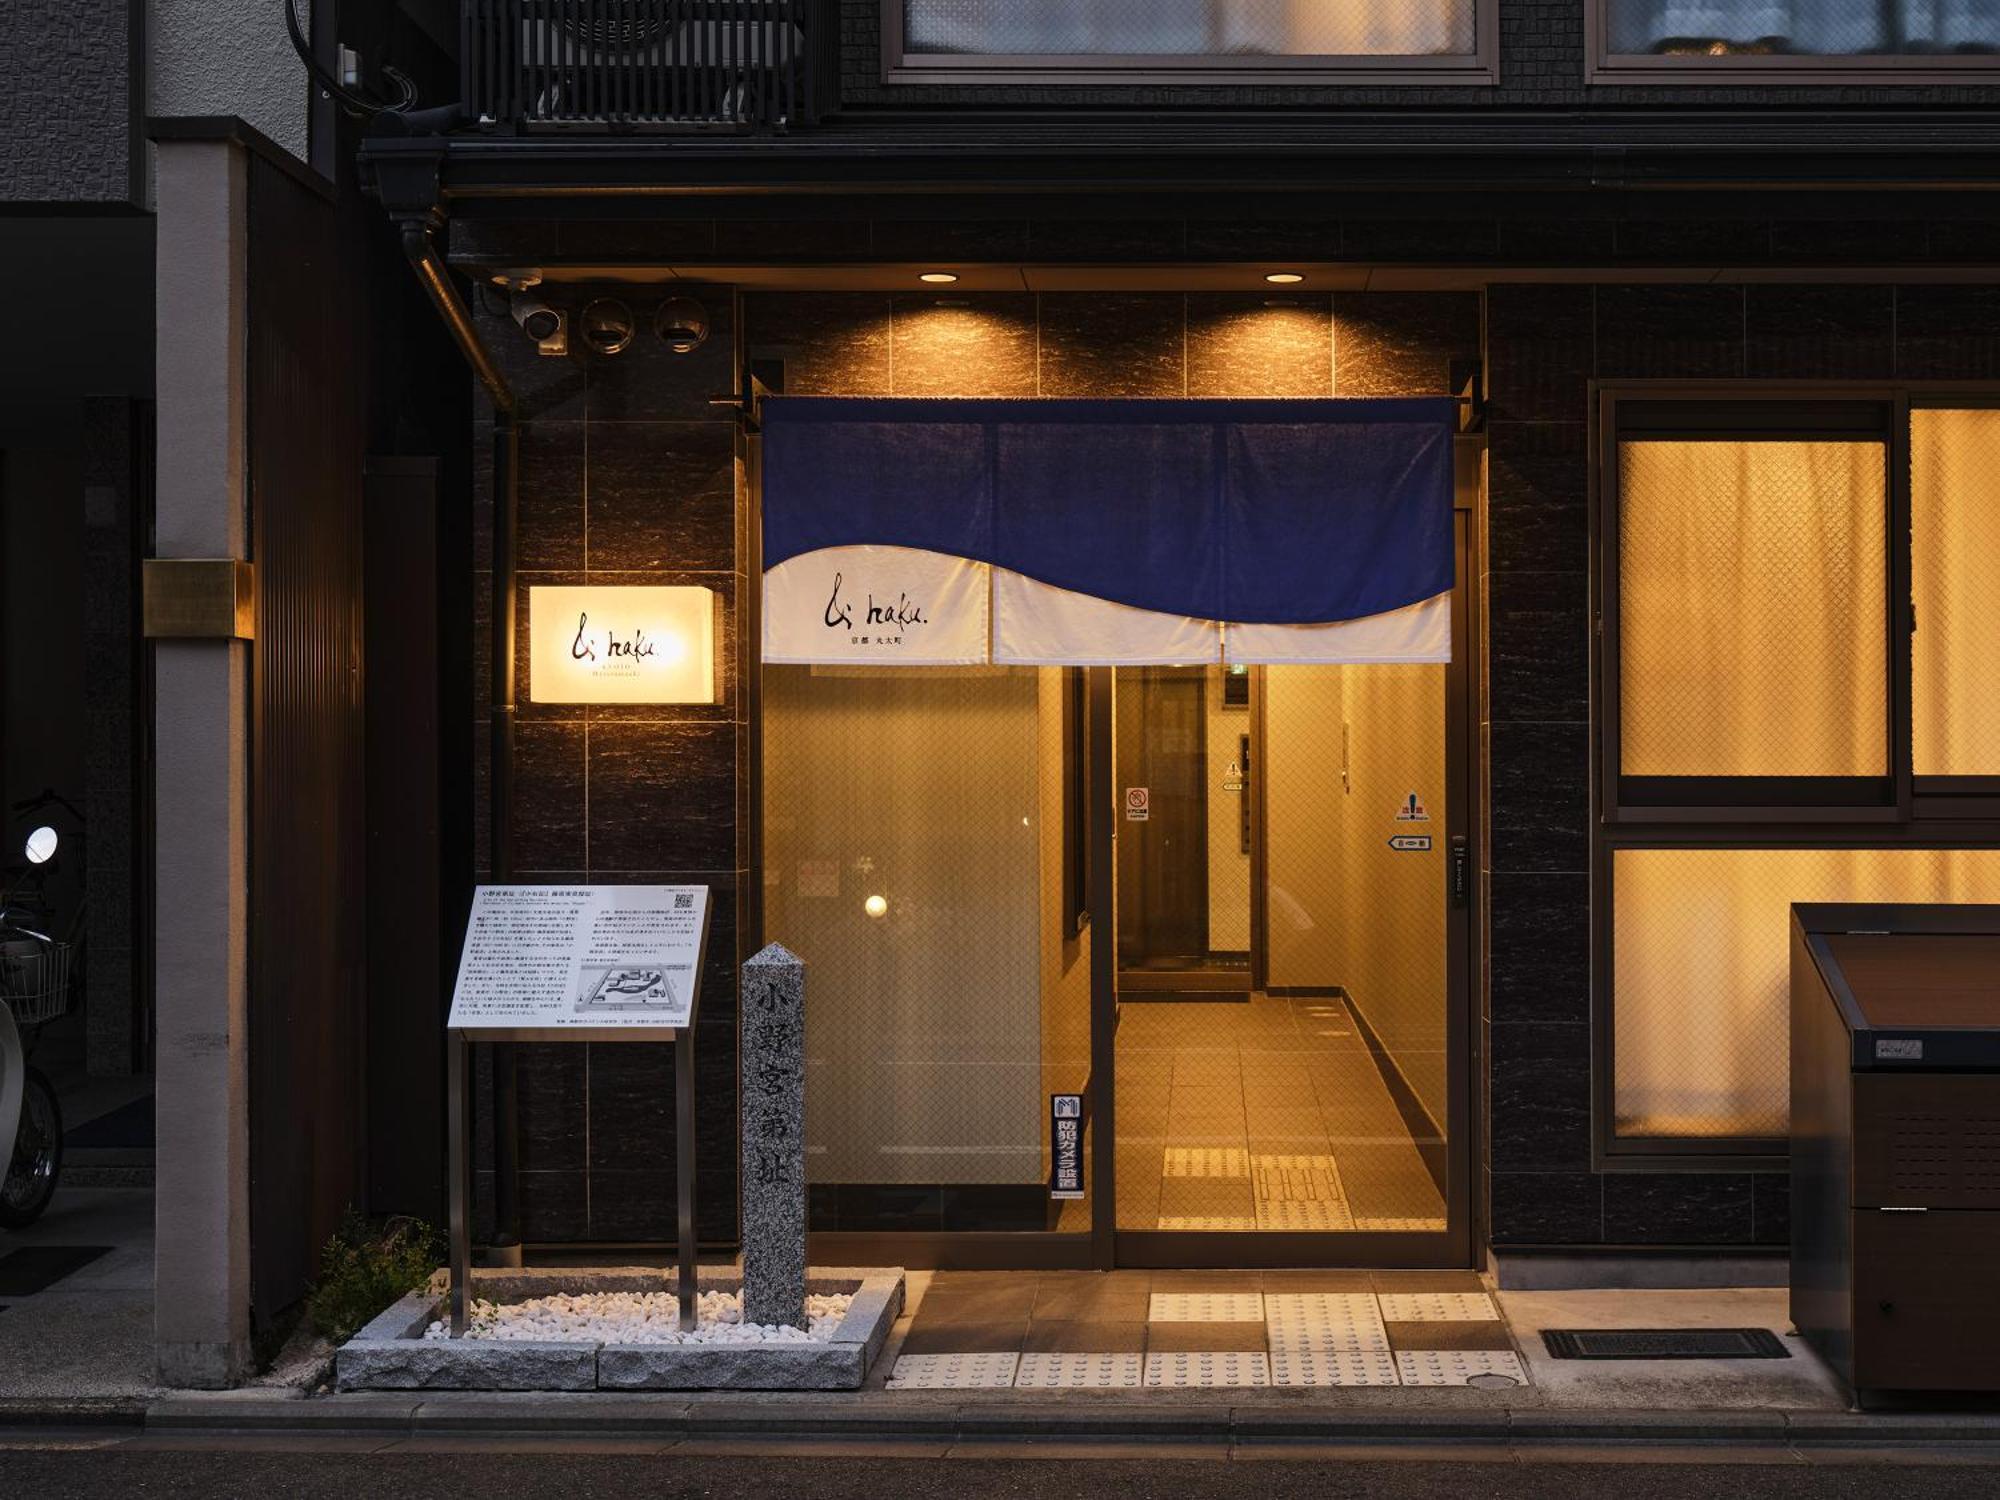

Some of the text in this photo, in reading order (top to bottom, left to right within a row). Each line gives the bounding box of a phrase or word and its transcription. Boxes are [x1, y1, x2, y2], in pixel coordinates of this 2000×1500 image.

[1057, 1120, 1077, 1189] 防犯カメラ設置
